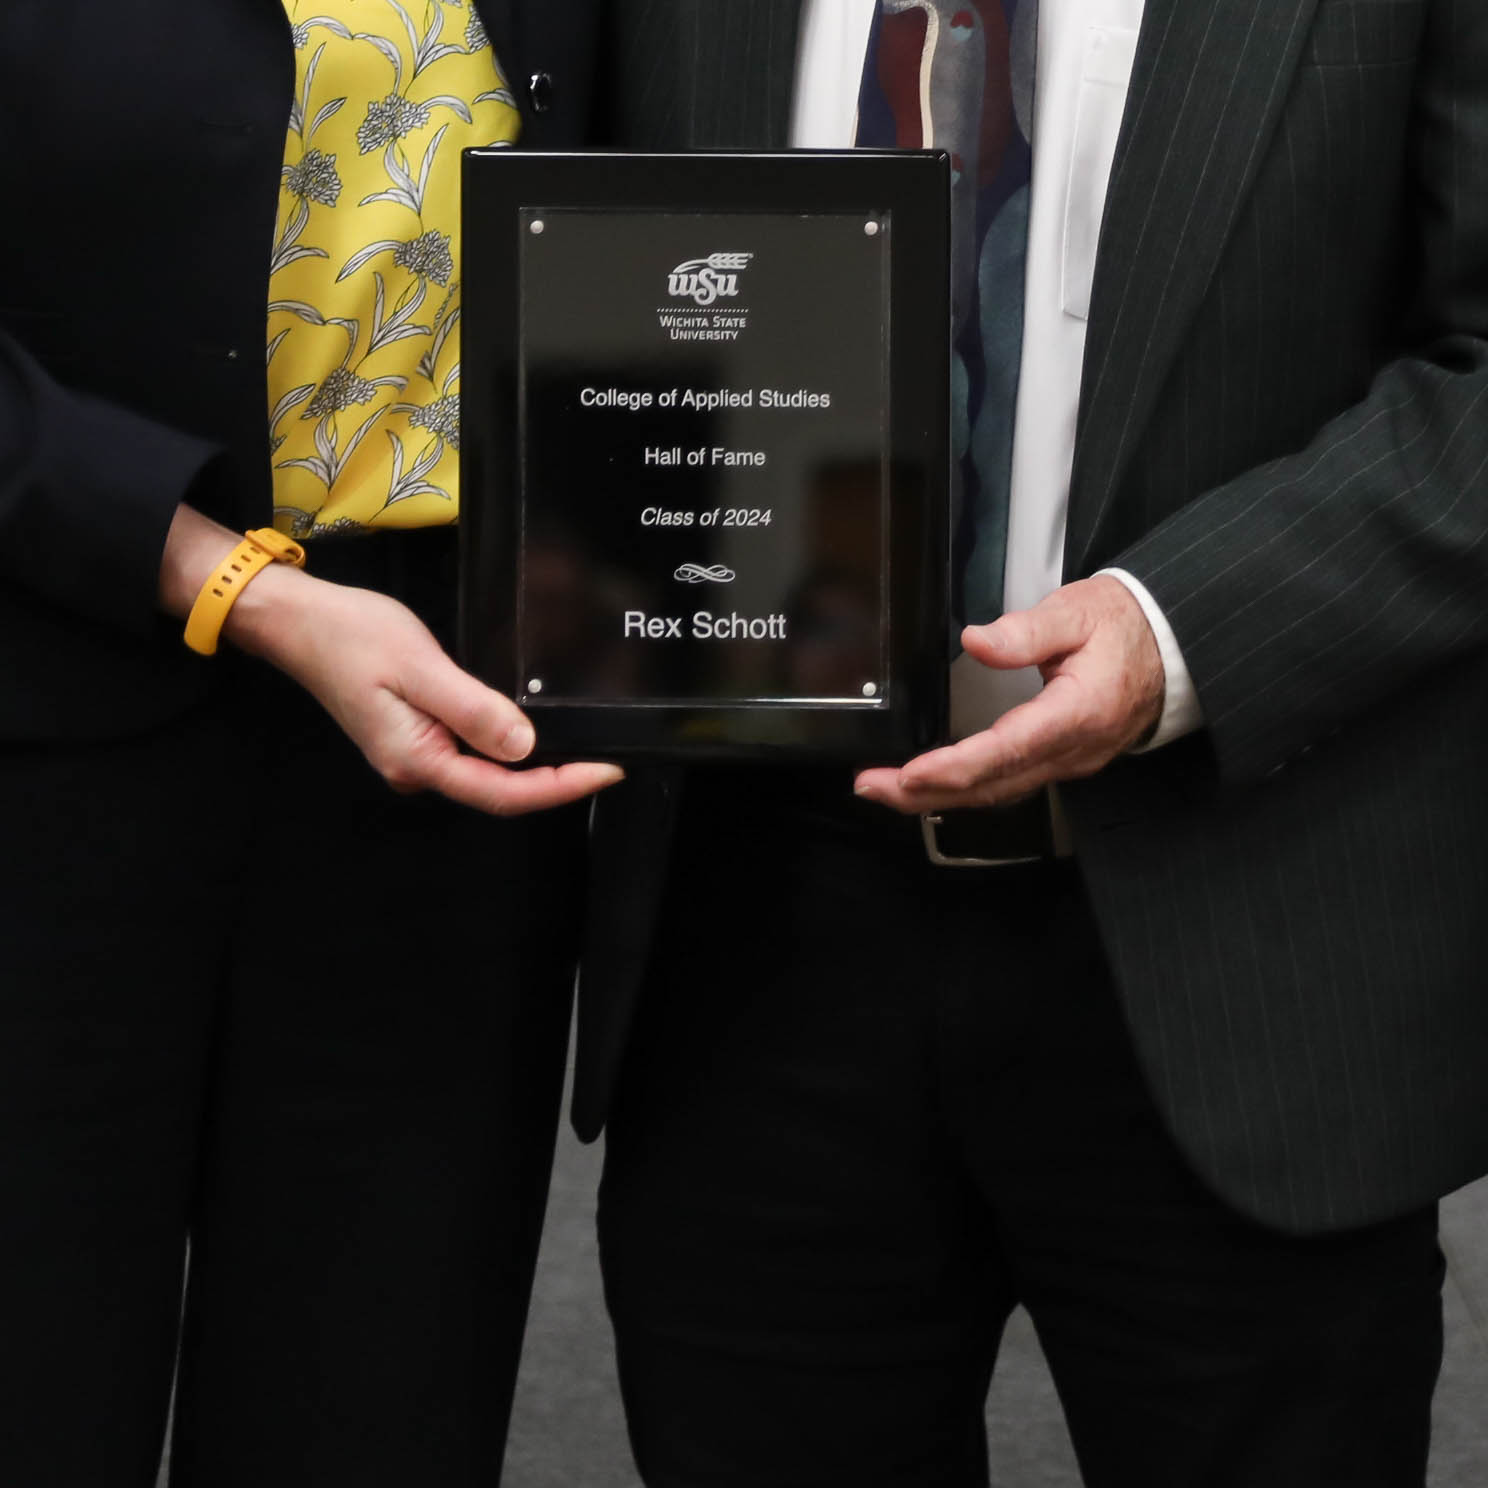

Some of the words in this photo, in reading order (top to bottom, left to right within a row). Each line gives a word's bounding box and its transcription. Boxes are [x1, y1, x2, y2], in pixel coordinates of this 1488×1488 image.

[580, 387, 653, 411] College
[658, 388, 678, 408] of
[681, 388, 753, 412] Applied
[758, 388, 831, 409] Studies
[644, 447, 681, 465] Hall
[686, 447, 706, 466] of
[711, 447, 766, 466] Fame
[640, 507, 694, 527] Class
[699, 507, 721, 527] of
[722, 508, 772, 527] 2024
[623, 611, 683, 640] Rex
[691, 610, 787, 640] Schott
